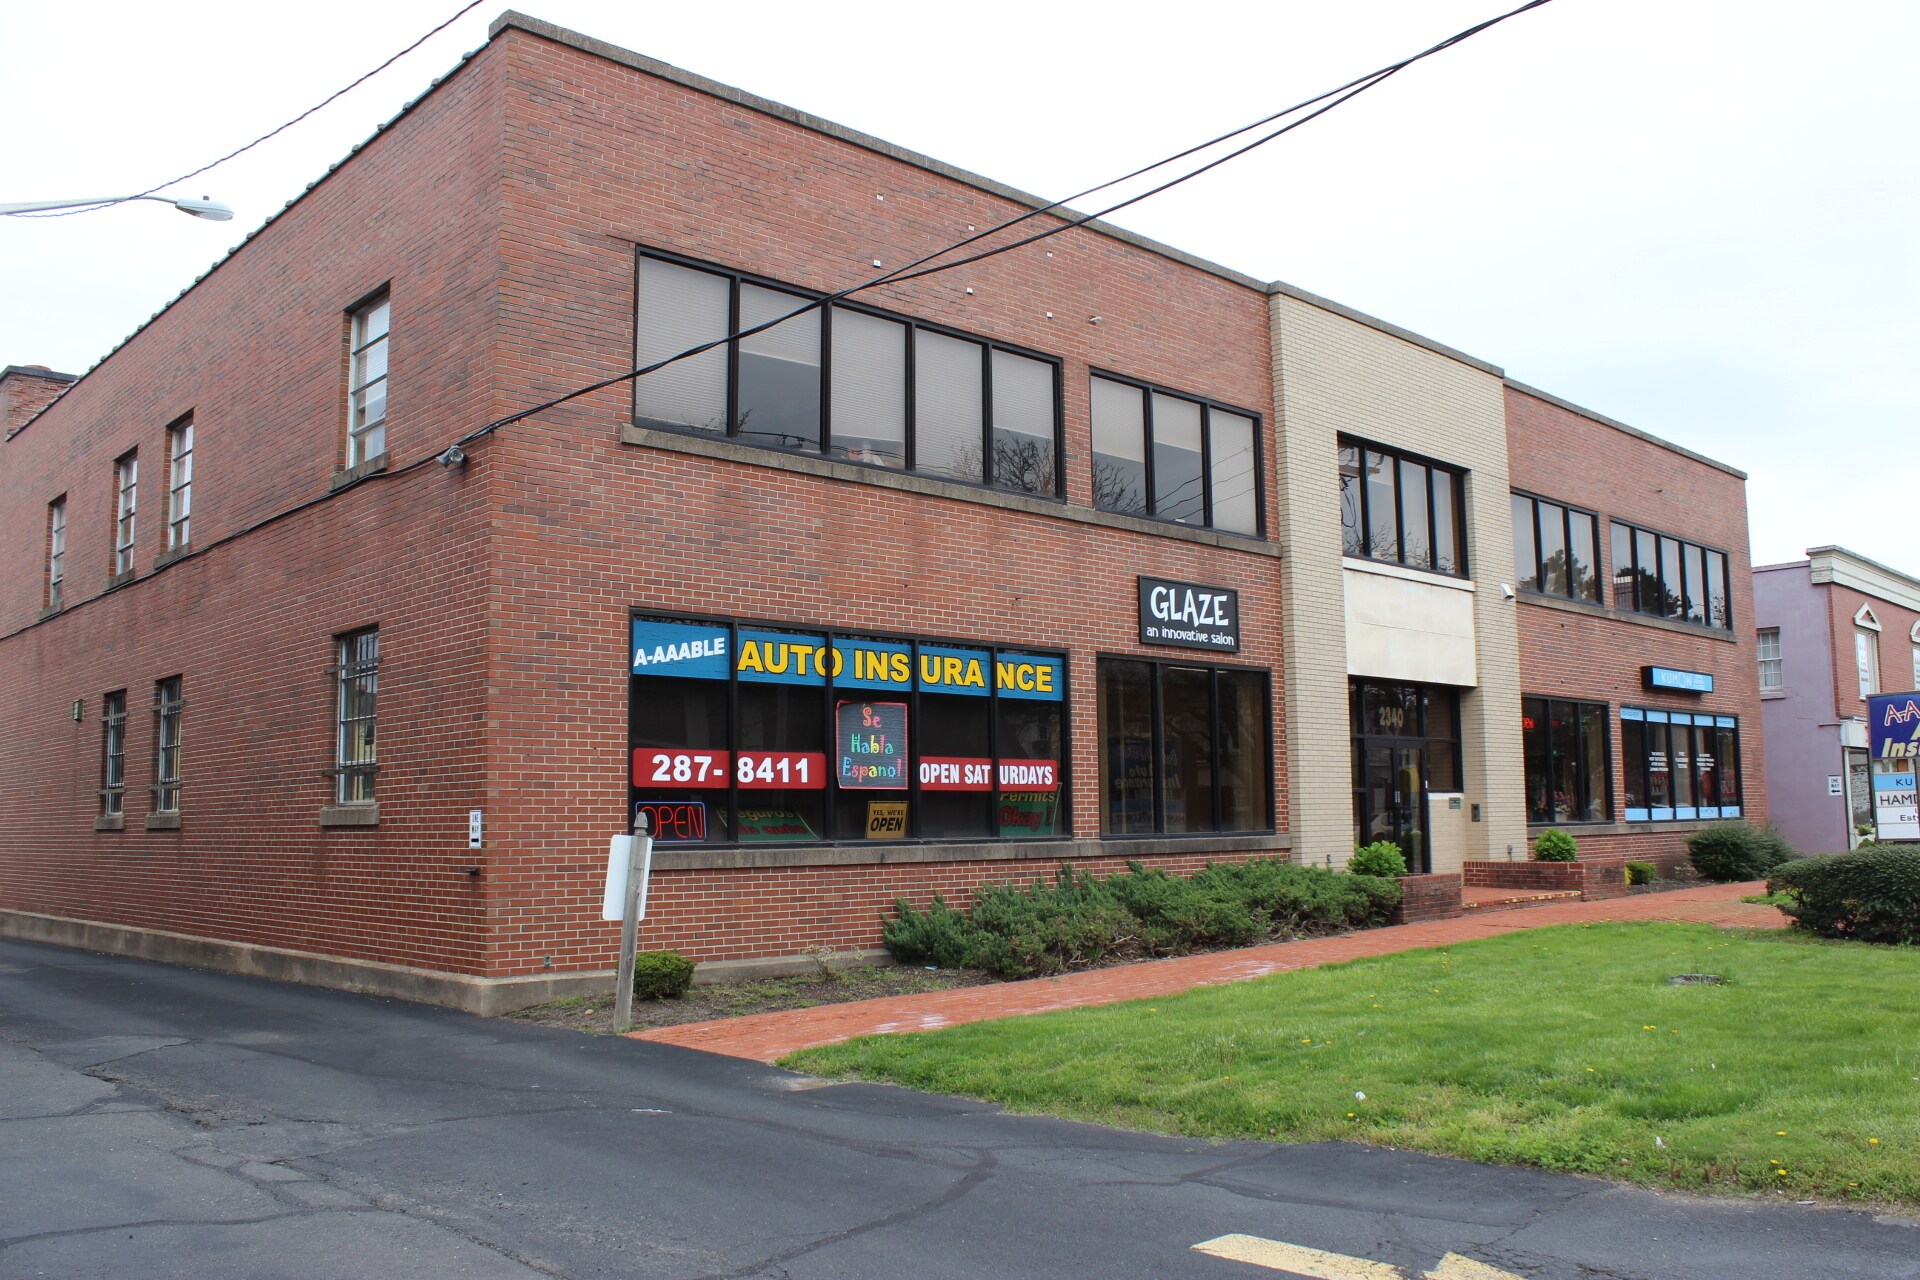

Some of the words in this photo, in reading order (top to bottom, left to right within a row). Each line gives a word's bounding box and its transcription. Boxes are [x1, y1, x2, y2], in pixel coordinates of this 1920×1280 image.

[1150, 586, 1229, 628] GLAZE
[1146, 626, 1159, 638] an
[1161, 626, 1209, 643] innovative
[1211, 632, 1235, 646] salon
[633, 637, 725, 667] A-AAABLE
[737, 640, 843, 677] AUTO
[1661, 671, 1692, 688] KUMON
[862, 706, 882, 729] Se
[1379, 706, 1404, 728] 2340
[851, 733, 894, 755] Habla
[842, 756, 902, 782] Espanol
[920, 763, 960, 784] OPEN
[965, 764, 1053, 785] SATURDAYS
[1000, 790, 1056, 803] Permits
[472, 813, 480, 822] ONE
[873, 809, 885, 817] YES,
[472, 824, 480, 833] WAY
[870, 817, 904, 832] OPEN
